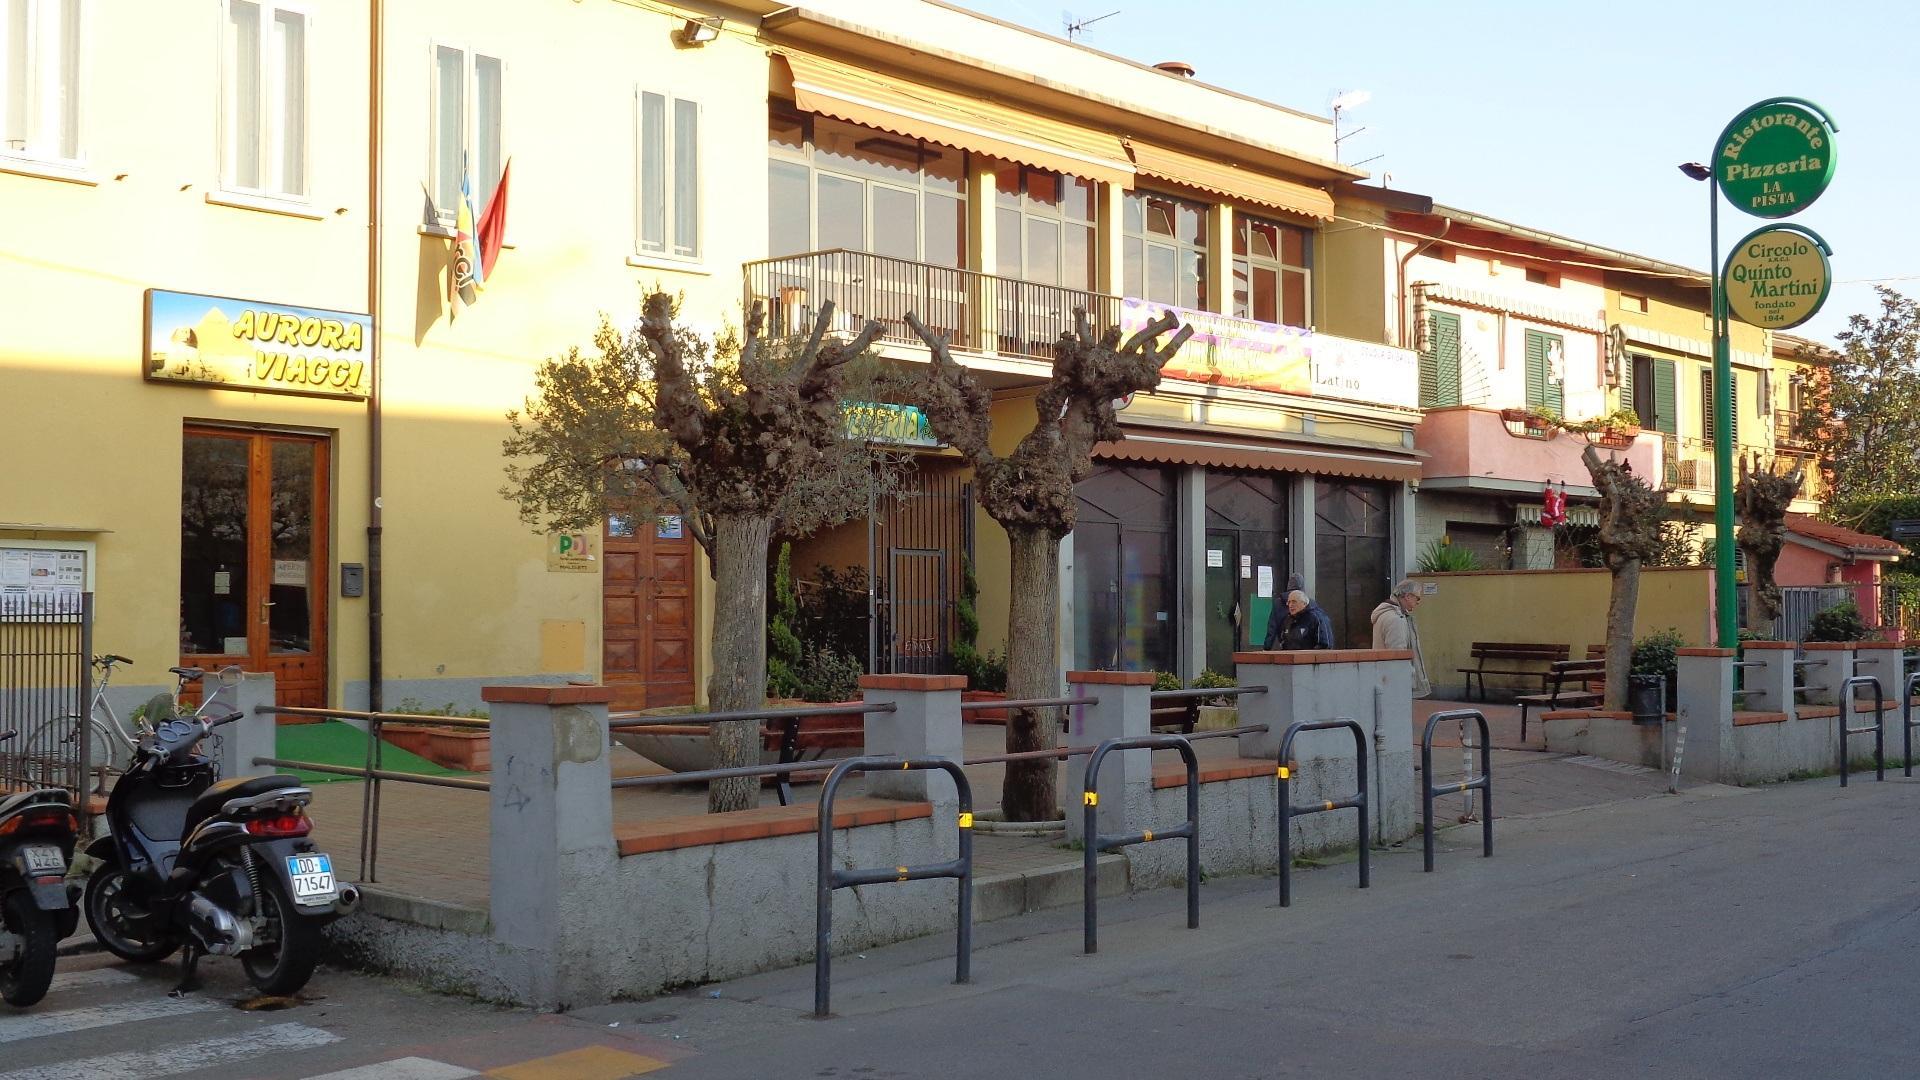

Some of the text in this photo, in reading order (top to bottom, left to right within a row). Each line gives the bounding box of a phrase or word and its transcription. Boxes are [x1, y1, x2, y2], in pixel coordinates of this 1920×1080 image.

[1723, 113, 1823, 160] Ristorante
[1726, 155, 1822, 181] Pizzeria
[1763, 181, 1781, 194] LA
[1752, 191, 1795, 208] PISTA
[1748, 242, 1808, 259] Circolo
[1733, 264, 1792, 282] Quinto
[1750, 279, 1817, 298] Martini
[1755, 300, 1796, 309] fondato
[1763, 314, 1785, 322] 1944
[233, 310, 363, 351] AURORA
[256, 351, 363, 388] VIAGGI
[1315, 363, 1360, 390] Latino
[298, 858, 314, 873] DD
[295, 875, 331, 893] 71547
